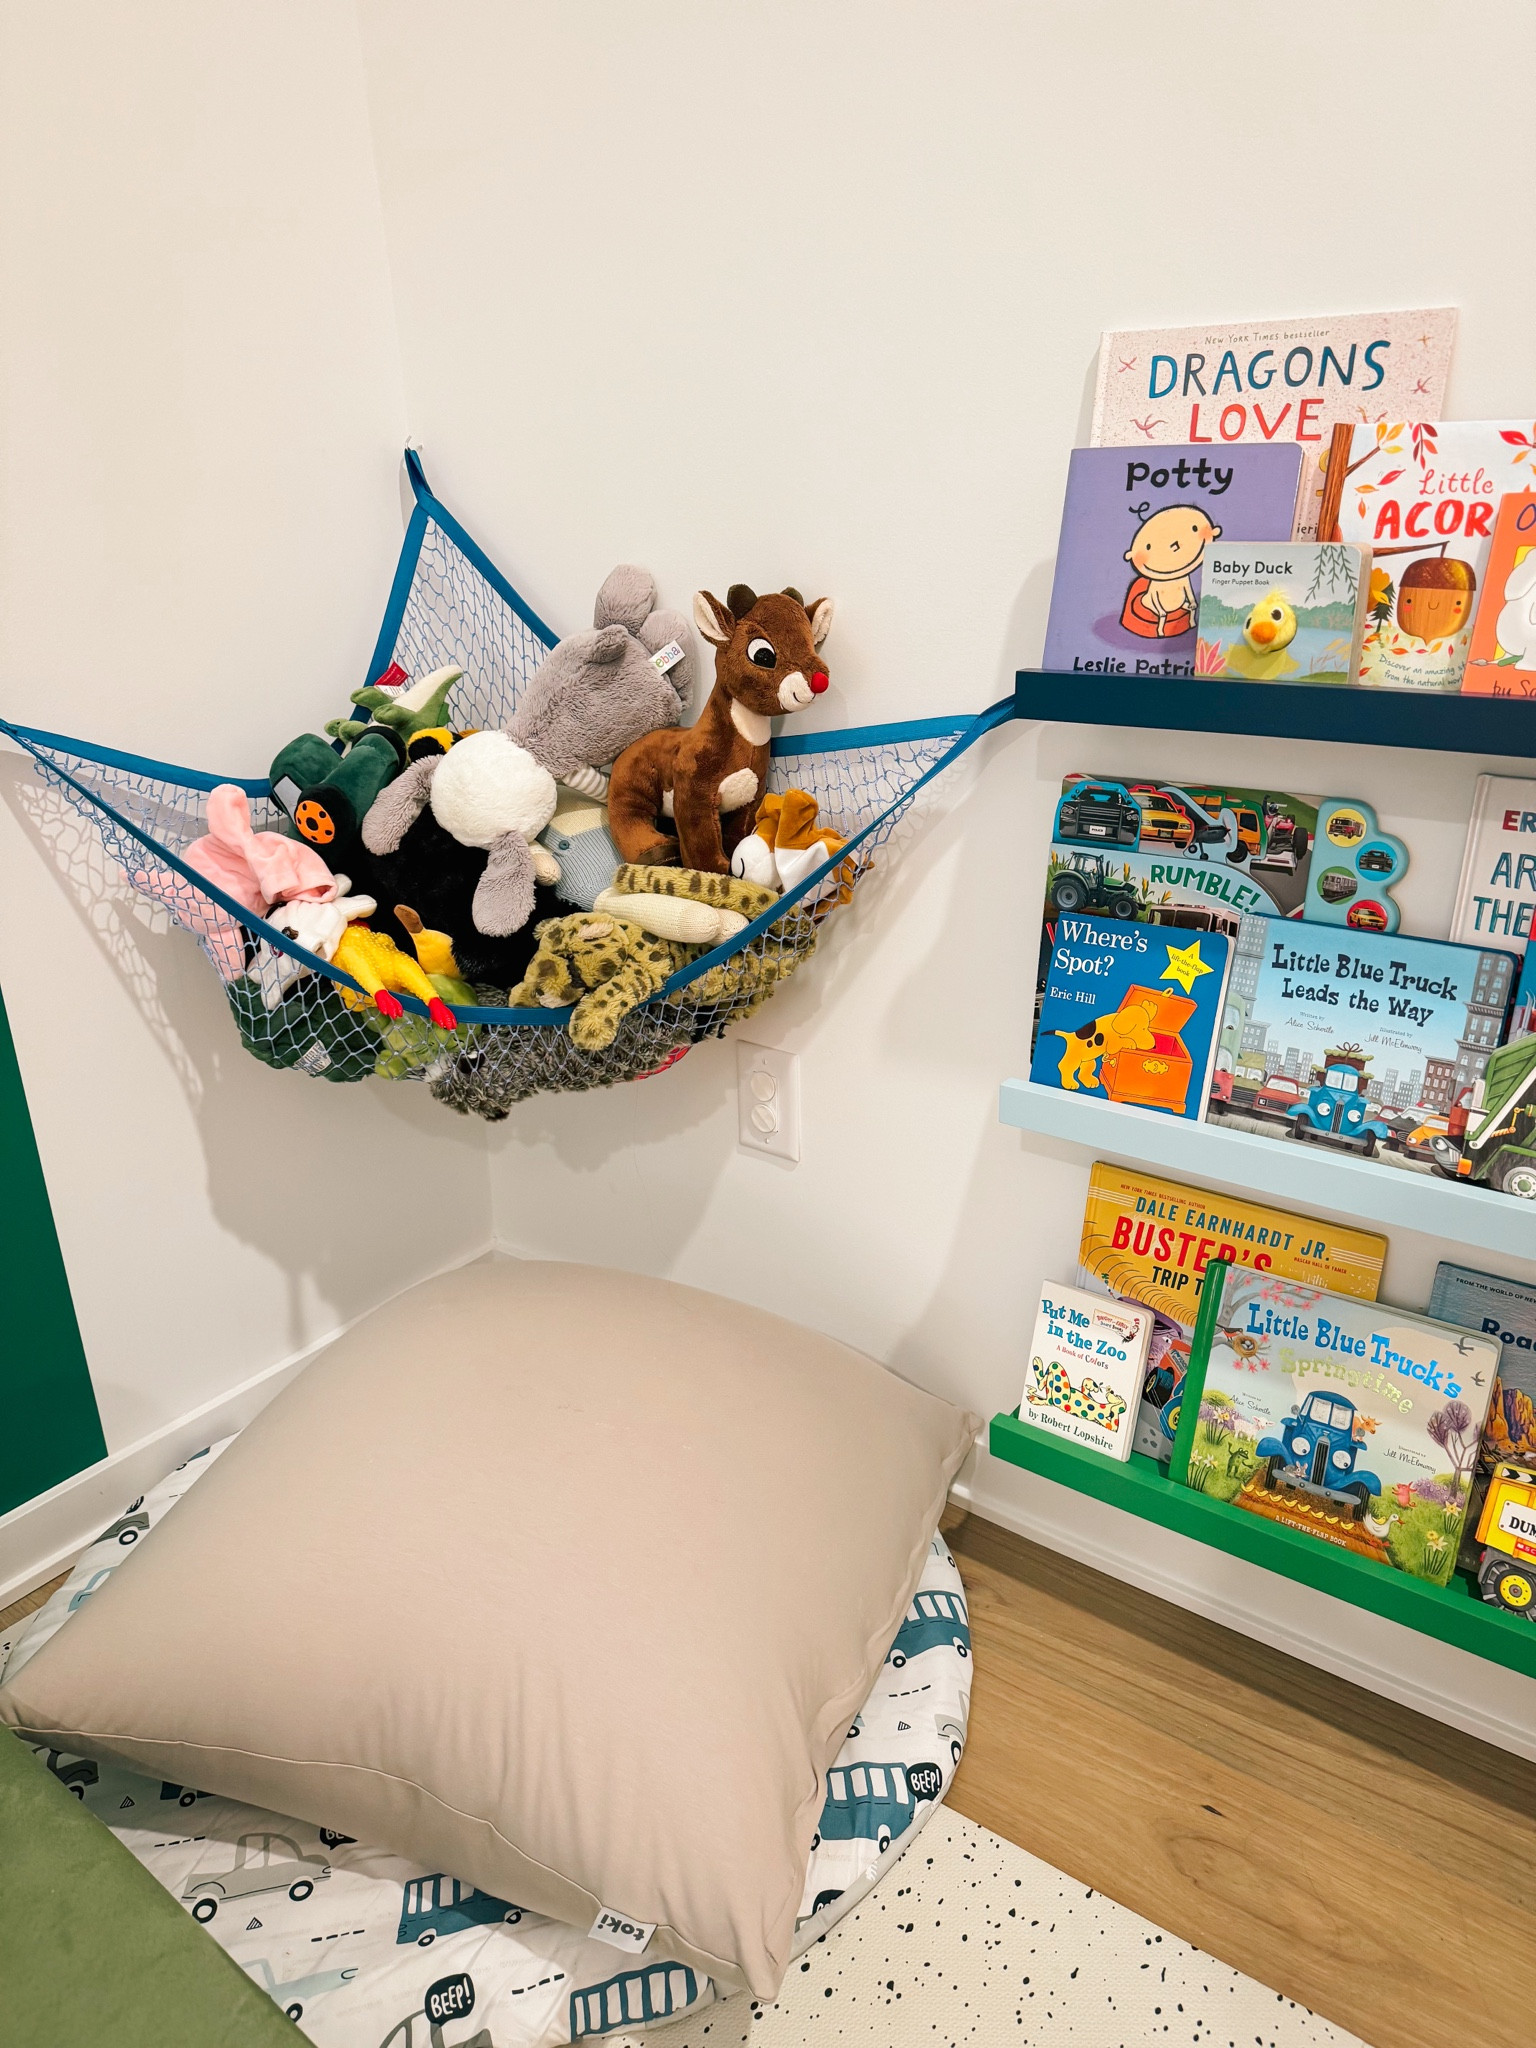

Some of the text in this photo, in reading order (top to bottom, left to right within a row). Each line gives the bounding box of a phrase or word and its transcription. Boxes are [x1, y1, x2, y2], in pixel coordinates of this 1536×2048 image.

[1284, 330, 1330, 339] bestseller
[1149, 340, 1391, 399] DRAGONS
[1189, 398, 1325, 443] LOVE
[1419, 468, 1494, 495] Little
[1373, 499, 1494, 540] ACOR
[1213, 560, 1293, 577] Baby Duck
[1211, 578, 1230, 586] Finger
[655, 646, 681, 668] ebba
[1073, 656, 1126, 672] Leslie
[1379, 654, 1411, 671] Discover
[1424, 666, 1455, 676] amazing
[1384, 670, 1400, 681] from
[1403, 675, 1415, 684] the
[1417, 677, 1445, 687] natural
[1151, 864, 1262, 913] RUMBLE!
[1061, 919, 1148, 953] Where's
[1054, 948, 1115, 977] Spot?
[1171, 953, 1204, 974] lift-the-flap
[1176, 966, 1190, 977] book
[1271, 943, 1458, 1001] Little Blue Truck
[1050, 986, 1096, 1005] Eric Hill
[1281, 977, 1434, 1027] Leads the Way
[1144, 1189, 1157, 1197] TIMES
[1158, 1193, 1187, 1205] BESTSELLING
[1135, 1195, 1330, 1262] DALE EARNHARDT JR.
[1151, 1265, 1189, 1291] TRIP
[1456, 1277, 1475, 1286] FROM
[1475, 1282, 1489, 1291] THE
[1489, 1286, 1514, 1297] WORLD
[1041, 1299, 1090, 1329] Put Me
[1047, 1320, 1127, 1362] in the Zoo
[1246, 1302, 1463, 1399] Little Blue Truck's
[1062, 1346, 1077, 1357] Book
[1085, 1354, 1109, 1370] Colors
[1279, 1347, 1415, 1415] Springtime
[1028, 1407, 1113, 1451] by Robert Lopshire
[1384, 1448, 1397, 1459] Jill
[1329, 1535, 1347, 1547] BOOK
[911, 1768, 941, 1793] BEEP!
[597, 1913, 645, 1941] toki
[430, 1976, 472, 2018] BEEP!
